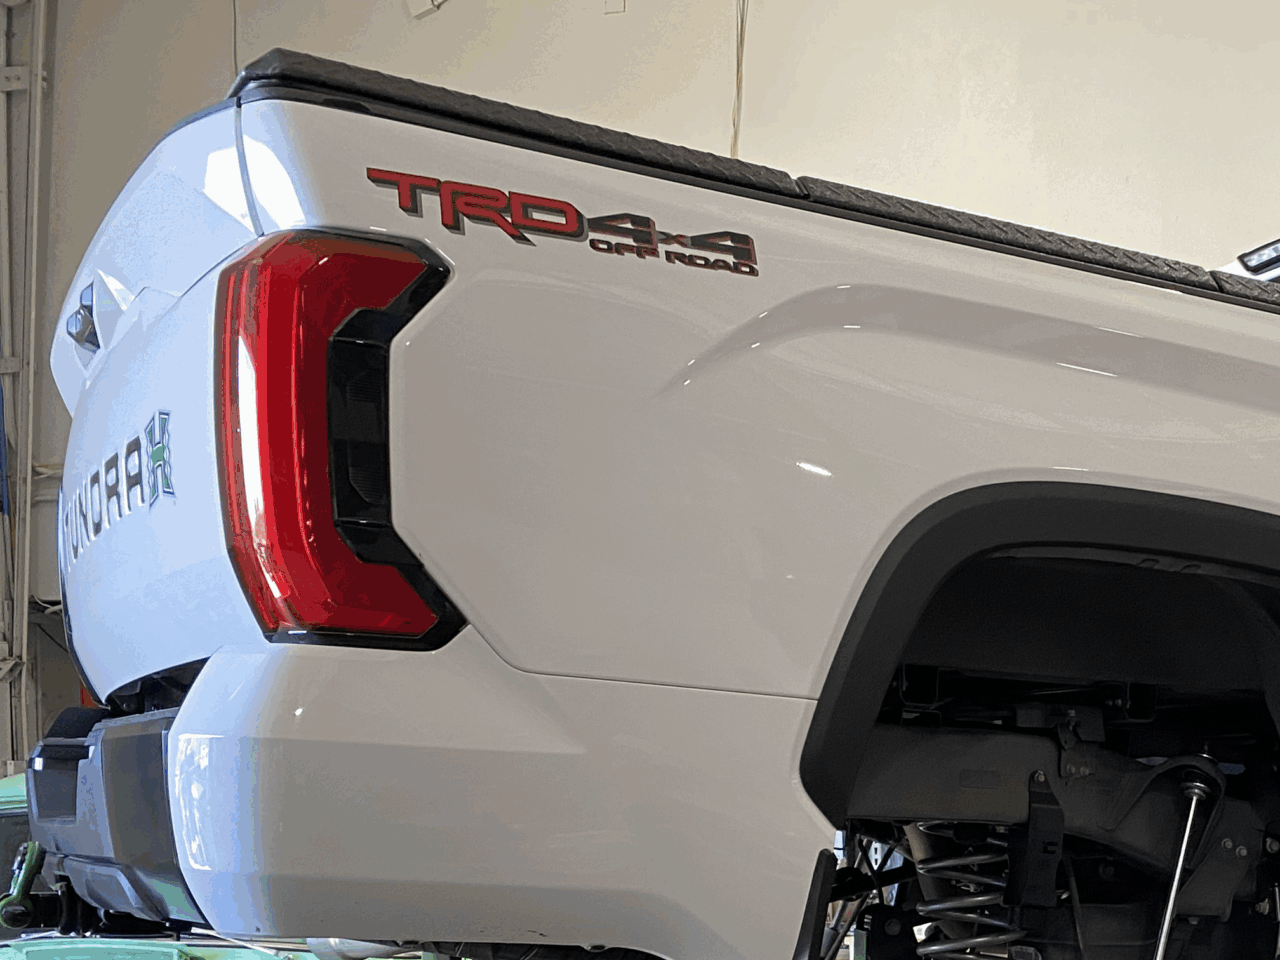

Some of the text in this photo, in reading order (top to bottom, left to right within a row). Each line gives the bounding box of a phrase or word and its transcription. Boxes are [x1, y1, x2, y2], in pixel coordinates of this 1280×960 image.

[366, 167, 588, 247] TRD
[589, 238, 760, 277] OFF ROAD
